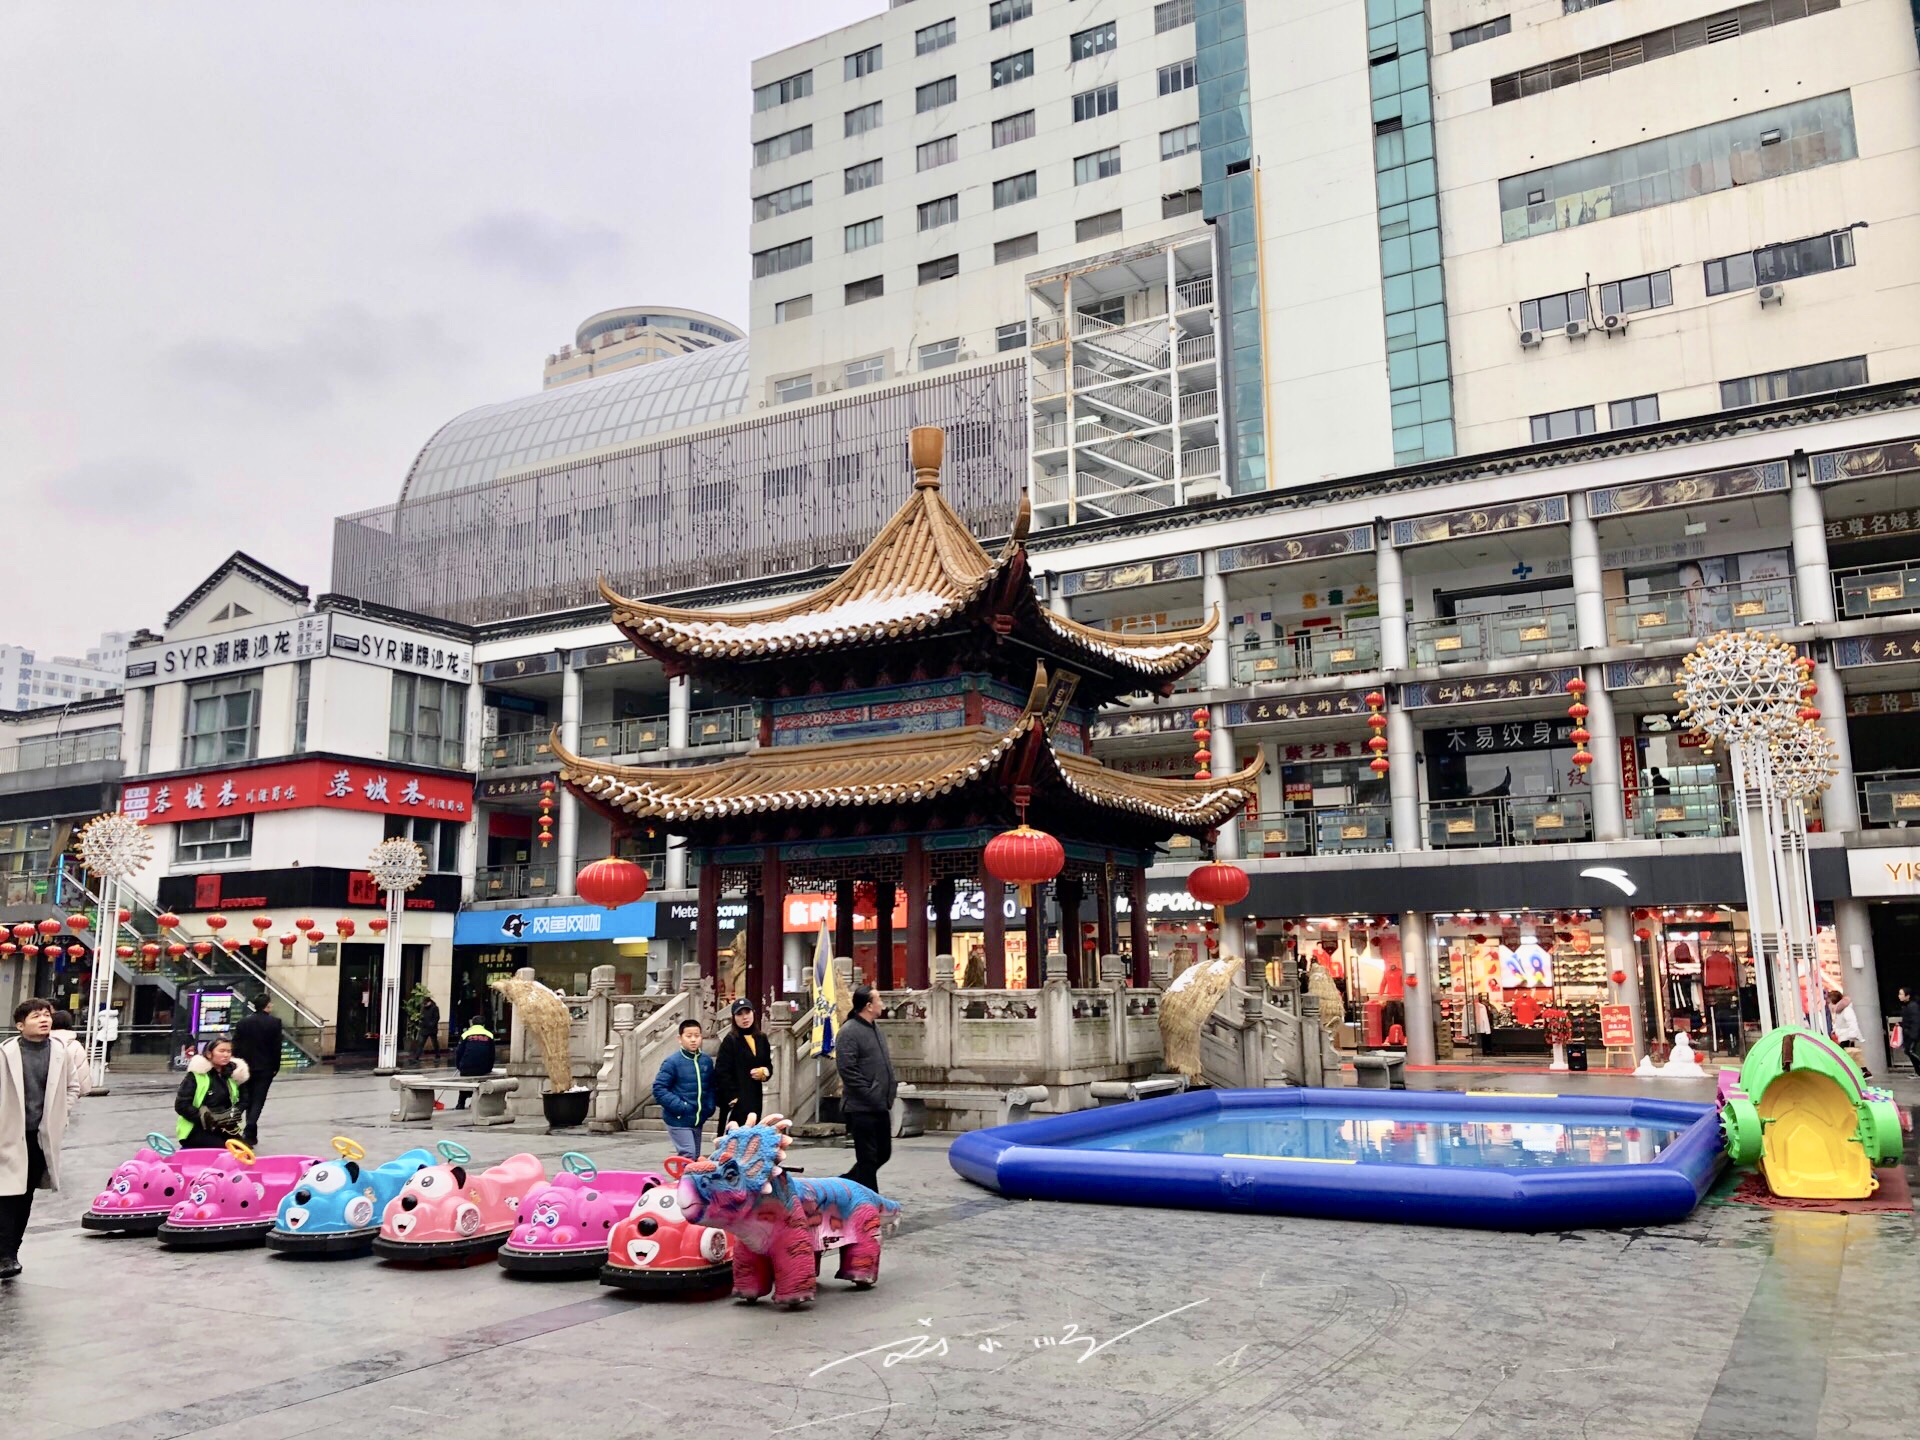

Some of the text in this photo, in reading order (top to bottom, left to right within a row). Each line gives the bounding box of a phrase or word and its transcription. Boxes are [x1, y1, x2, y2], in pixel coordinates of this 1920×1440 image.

[1447, 721, 1552, 751] 木易纹身
[533, 913, 602, 934] 网鱼网咖
